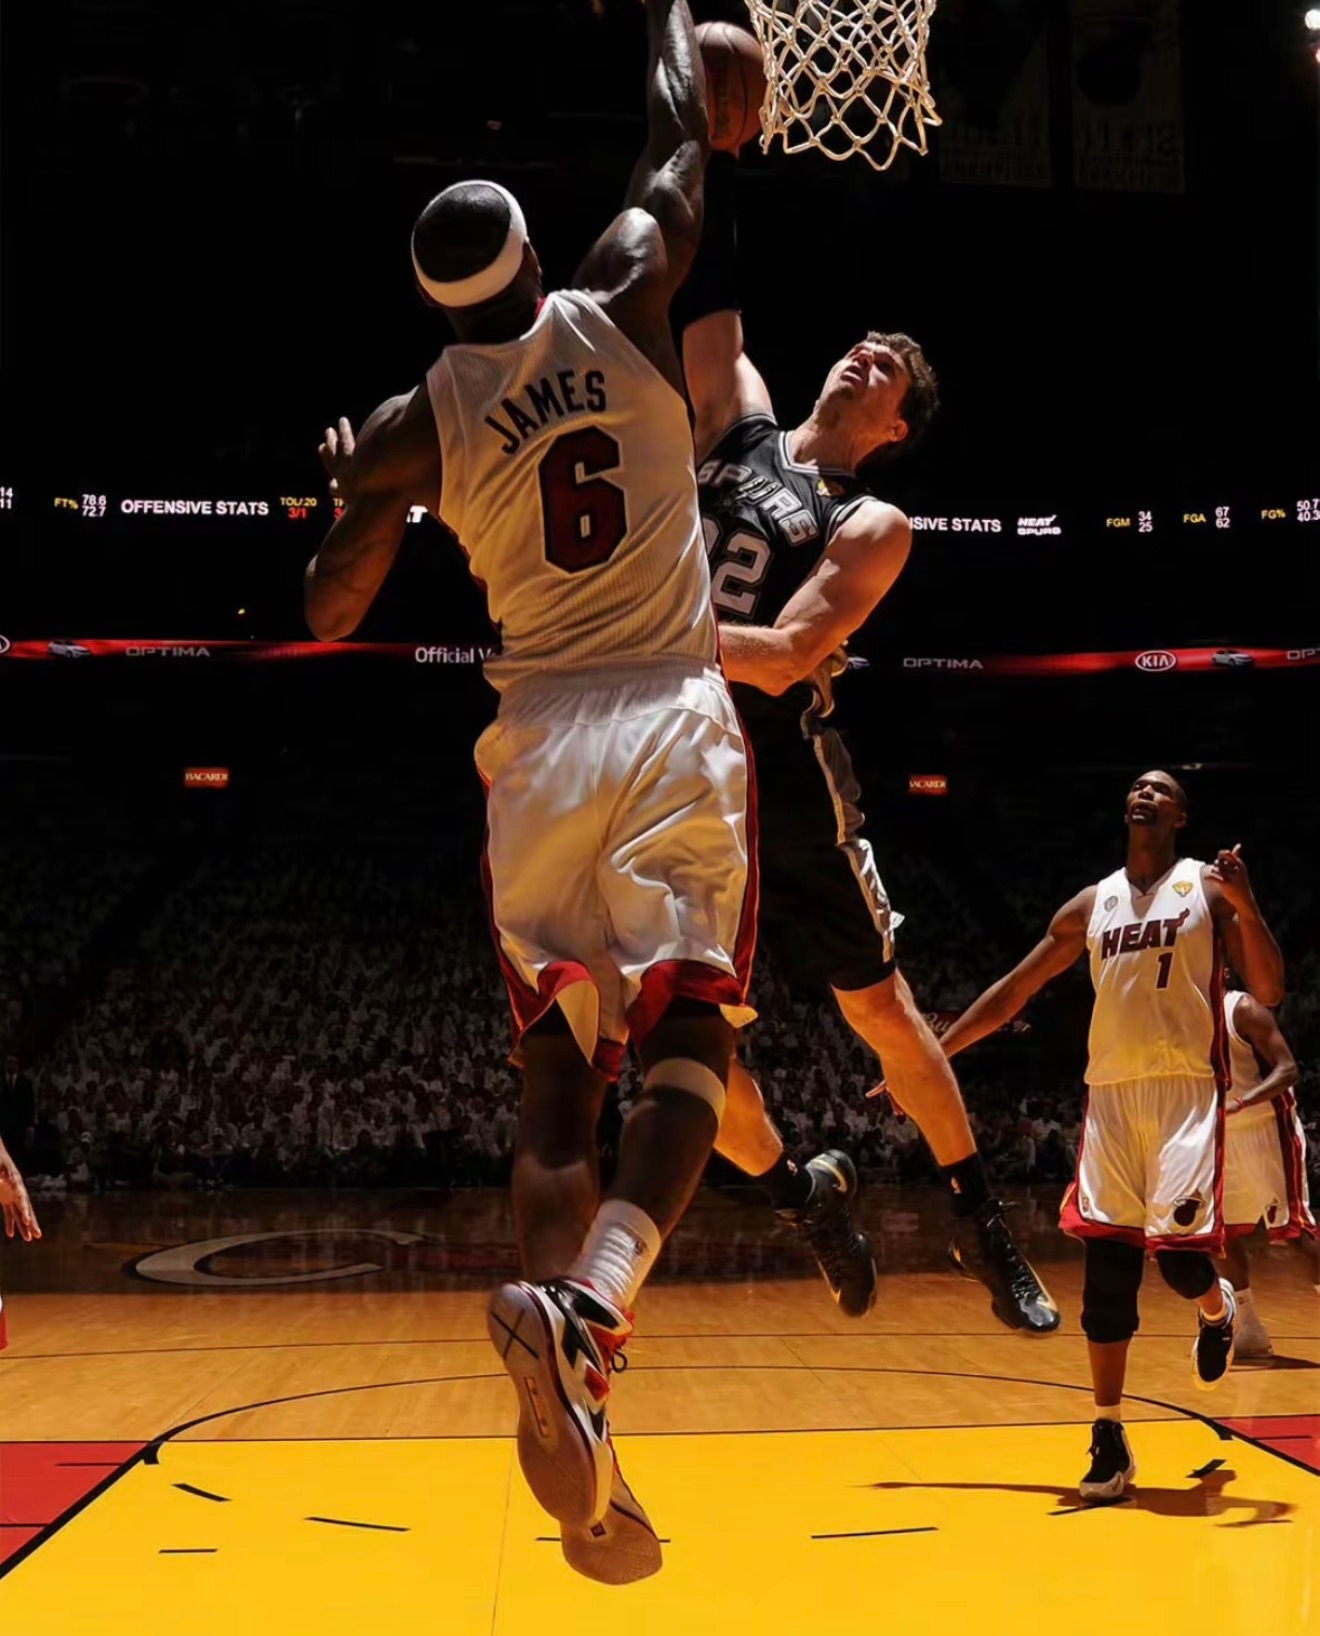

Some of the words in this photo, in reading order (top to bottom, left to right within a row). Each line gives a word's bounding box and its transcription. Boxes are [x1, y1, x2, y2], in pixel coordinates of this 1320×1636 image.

[484, 369, 607, 455] JAMES
[54, 498, 79, 509] FT%
[82, 494, 107, 505] 78.6
[536, 425, 629, 575] 6
[696, 459, 820, 547] SPURS
[1297, 499, 1319, 511] 50.7
[82, 506, 106, 517] 72.7
[120, 499, 212, 514] OFFENSIVE
[215, 500, 269, 515] STATS
[288, 507, 307, 518] 3/1
[1215, 507, 1230, 517] 67
[1138, 511, 1152, 521] 34
[1183, 514, 1207, 523] FGA
[1261, 509, 1286, 519] FG%
[951, 518, 1002, 532] STATS
[1017, 515, 1057, 527] HEAT
[1106, 517, 1131, 527] FGM
[1215, 518, 1230, 528] 62
[1017, 526, 1062, 536] SPURS
[1138, 522, 1153, 533] 25
[701, 516, 777, 621] 2
[126, 647, 210, 657] OPTIMA
[415, 646, 474, 663] Official
[903, 657, 984, 669] OPTIMA
[1101, 907, 1190, 961] HEAT
[1156, 952, 1173, 989] 1
